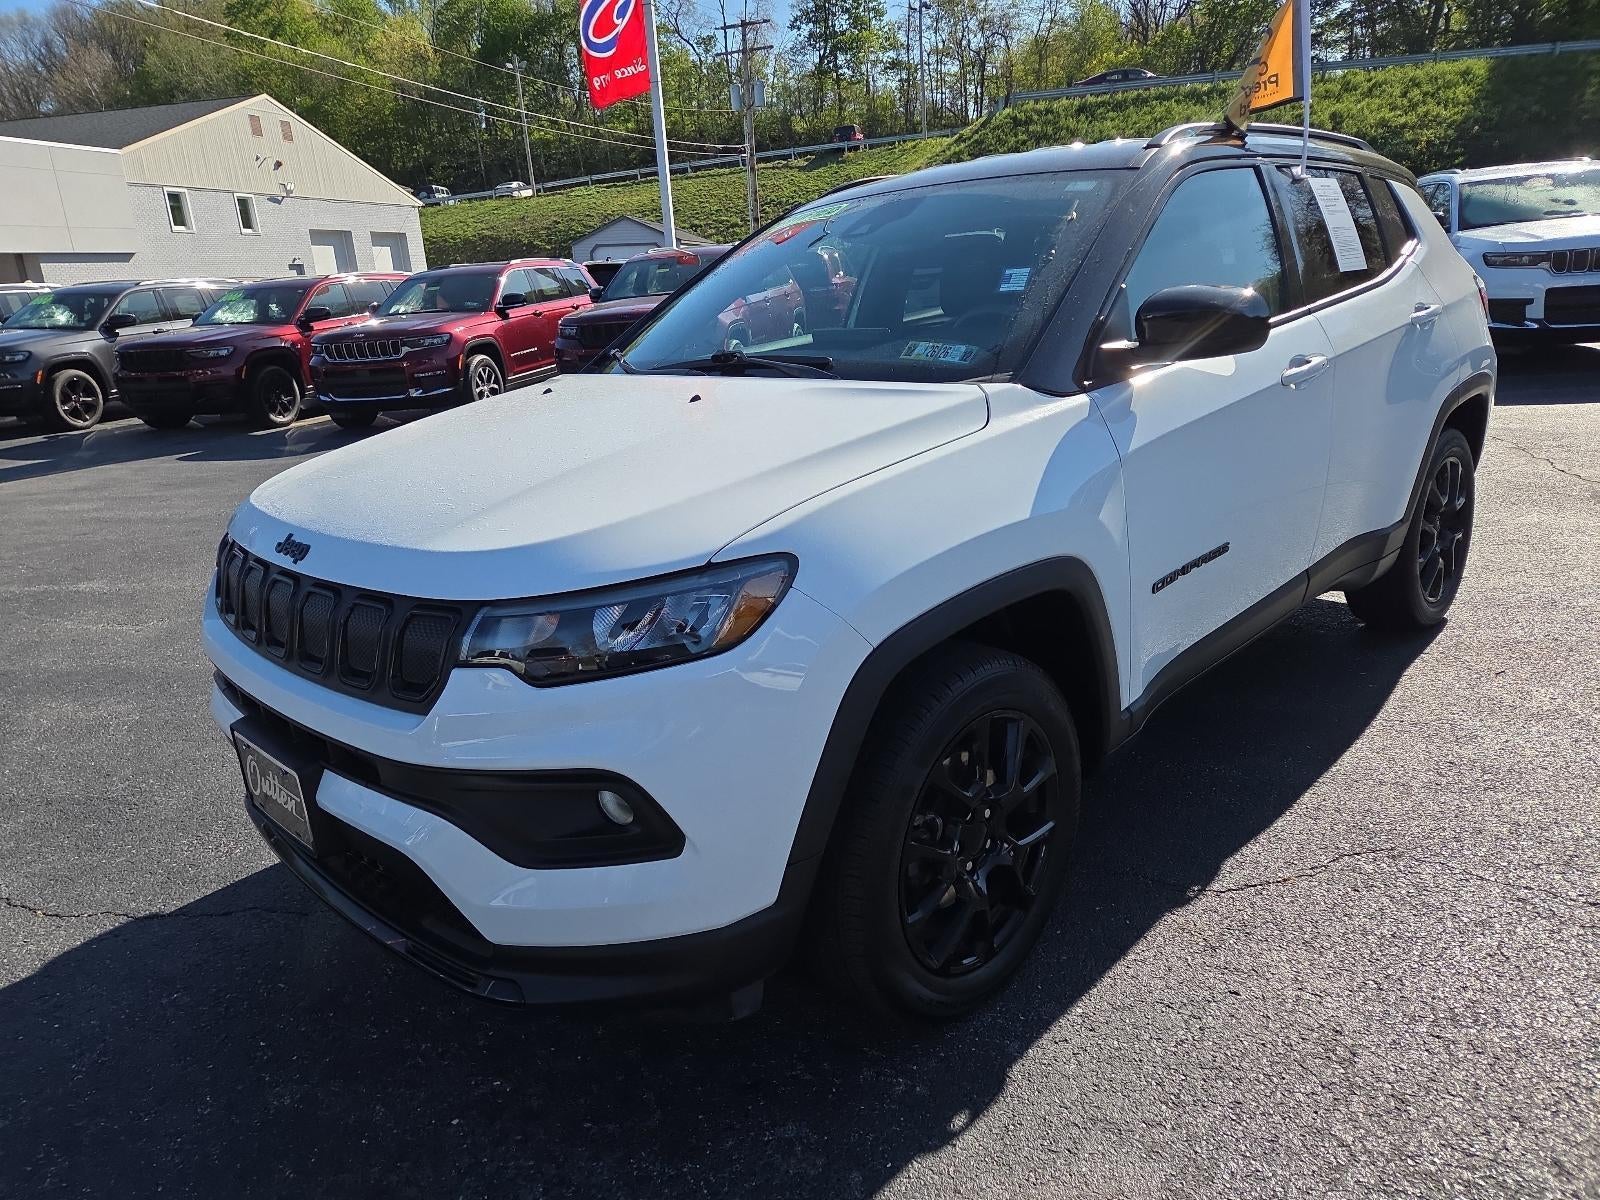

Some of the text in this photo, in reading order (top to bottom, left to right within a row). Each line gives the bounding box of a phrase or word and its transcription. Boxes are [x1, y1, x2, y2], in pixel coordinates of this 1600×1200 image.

[274, 532, 311, 565] Jeep
[1151, 541, 1230, 594] COMPASS
[246, 754, 304, 822] Outten
